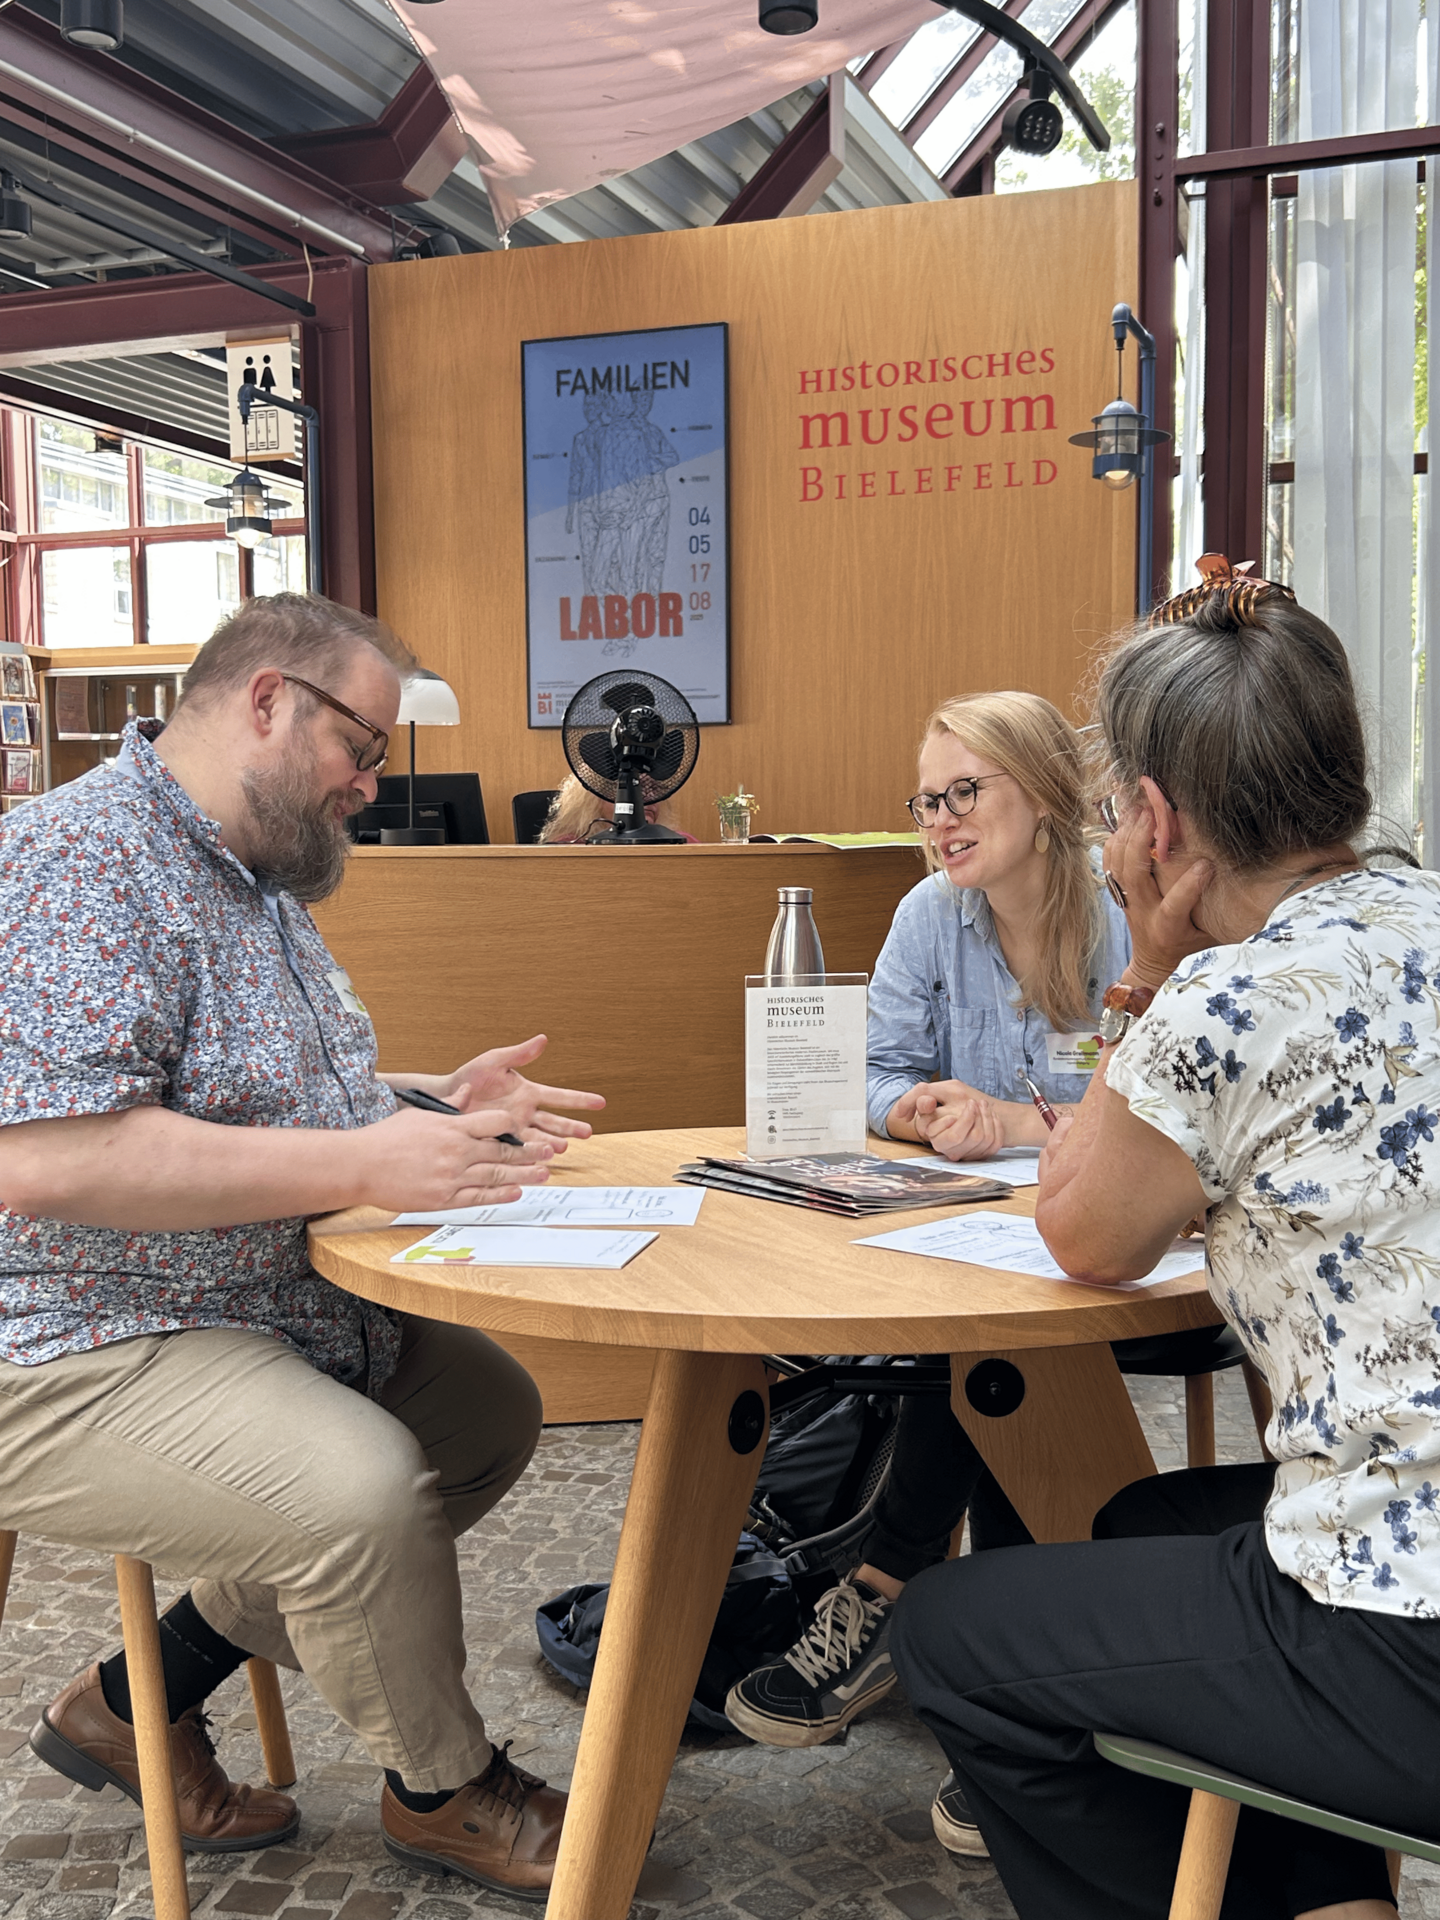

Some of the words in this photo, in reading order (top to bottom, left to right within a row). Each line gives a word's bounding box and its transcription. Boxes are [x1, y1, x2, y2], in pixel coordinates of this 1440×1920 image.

[556, 359, 690, 397] FAMILIEN
[798, 394, 1058, 450] museum
[688, 506, 711, 526] 04
[688, 535, 711, 554] 05
[690, 563, 711, 582] 17
[689, 591, 712, 610] 08
[559, 592, 684, 641] LABOR
[767, 1005, 825, 1016] museum
